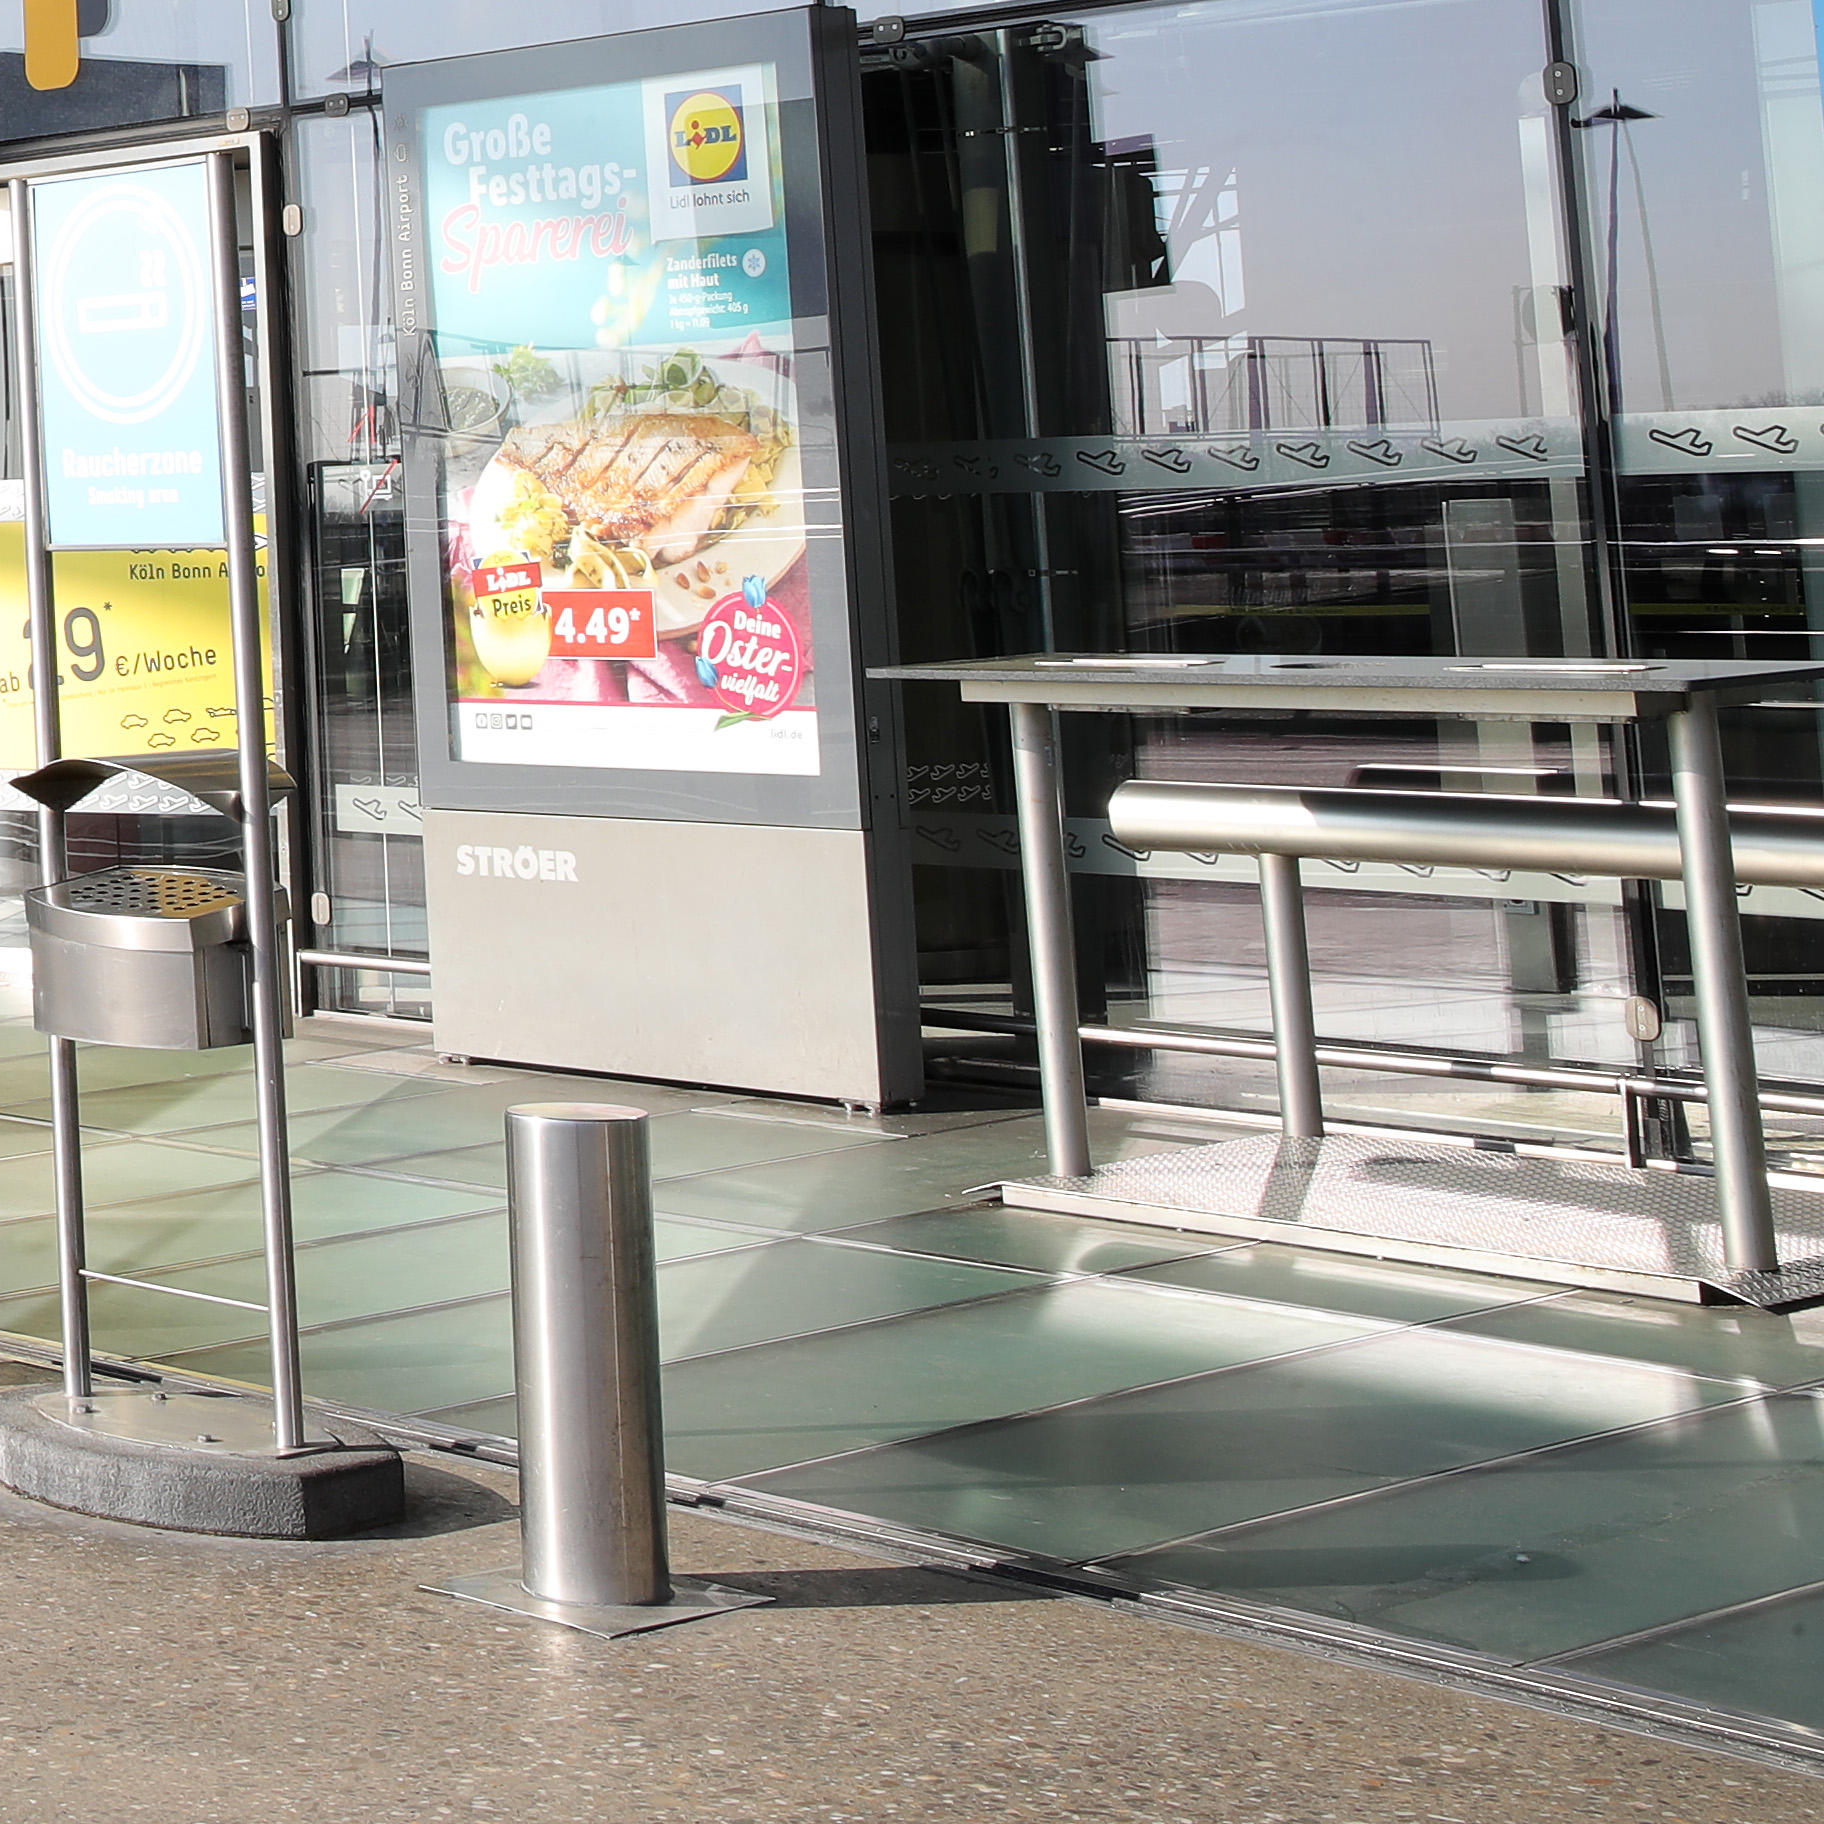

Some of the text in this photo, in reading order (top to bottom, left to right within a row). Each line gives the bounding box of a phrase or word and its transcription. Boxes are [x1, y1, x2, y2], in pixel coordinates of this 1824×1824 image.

[444, 113, 551, 166] Große
[468, 159, 637, 210] Festtags-
[669, 188, 750, 209] Lidl lohnt sich
[398, 174, 416, 337] Köln Bonn Airport
[441, 197, 634, 293] Sparerei
[666, 252, 738, 272] Zanderfilets
[667, 272, 720, 289] mit Haut
[727, 302, 742, 313] 405
[63, 447, 202, 479] Raucherzone
[88, 485, 179, 508] Smoking area
[129, 563, 165, 580] Köln
[172, 563, 212, 579] Bonn
[492, 554, 514, 565] Dein
[493, 598, 532, 617] Preis
[733, 611, 782, 640] Deine
[702, 620, 792, 675] Oster-
[0, 672, 20, 694] ab
[720, 668, 780, 705] vielfalt
[456, 844, 579, 882] STRÖER
